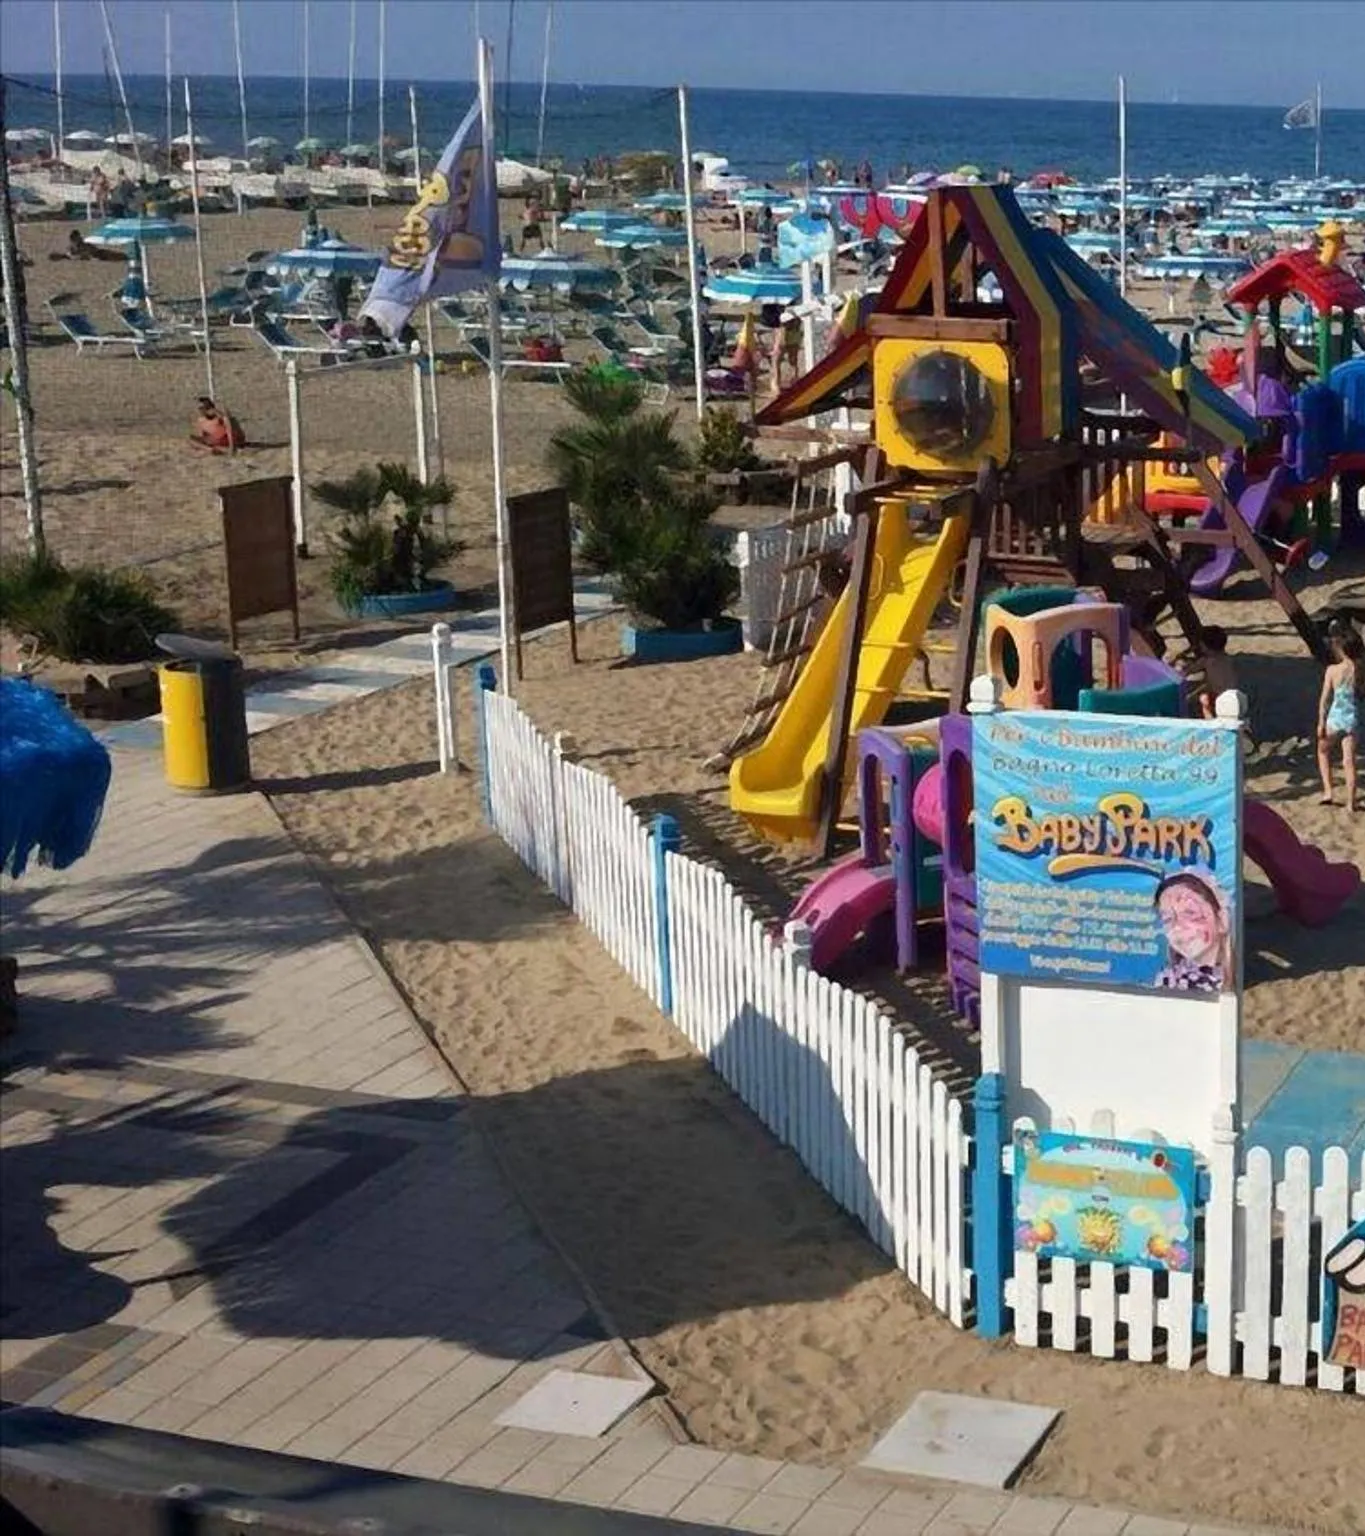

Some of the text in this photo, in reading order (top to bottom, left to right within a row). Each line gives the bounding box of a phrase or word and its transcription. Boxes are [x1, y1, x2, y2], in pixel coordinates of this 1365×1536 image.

[1085, 759, 1178, 783] Loretta
[1190, 766, 1219, 785] 99
[1098, 792, 1216, 871] PARK
